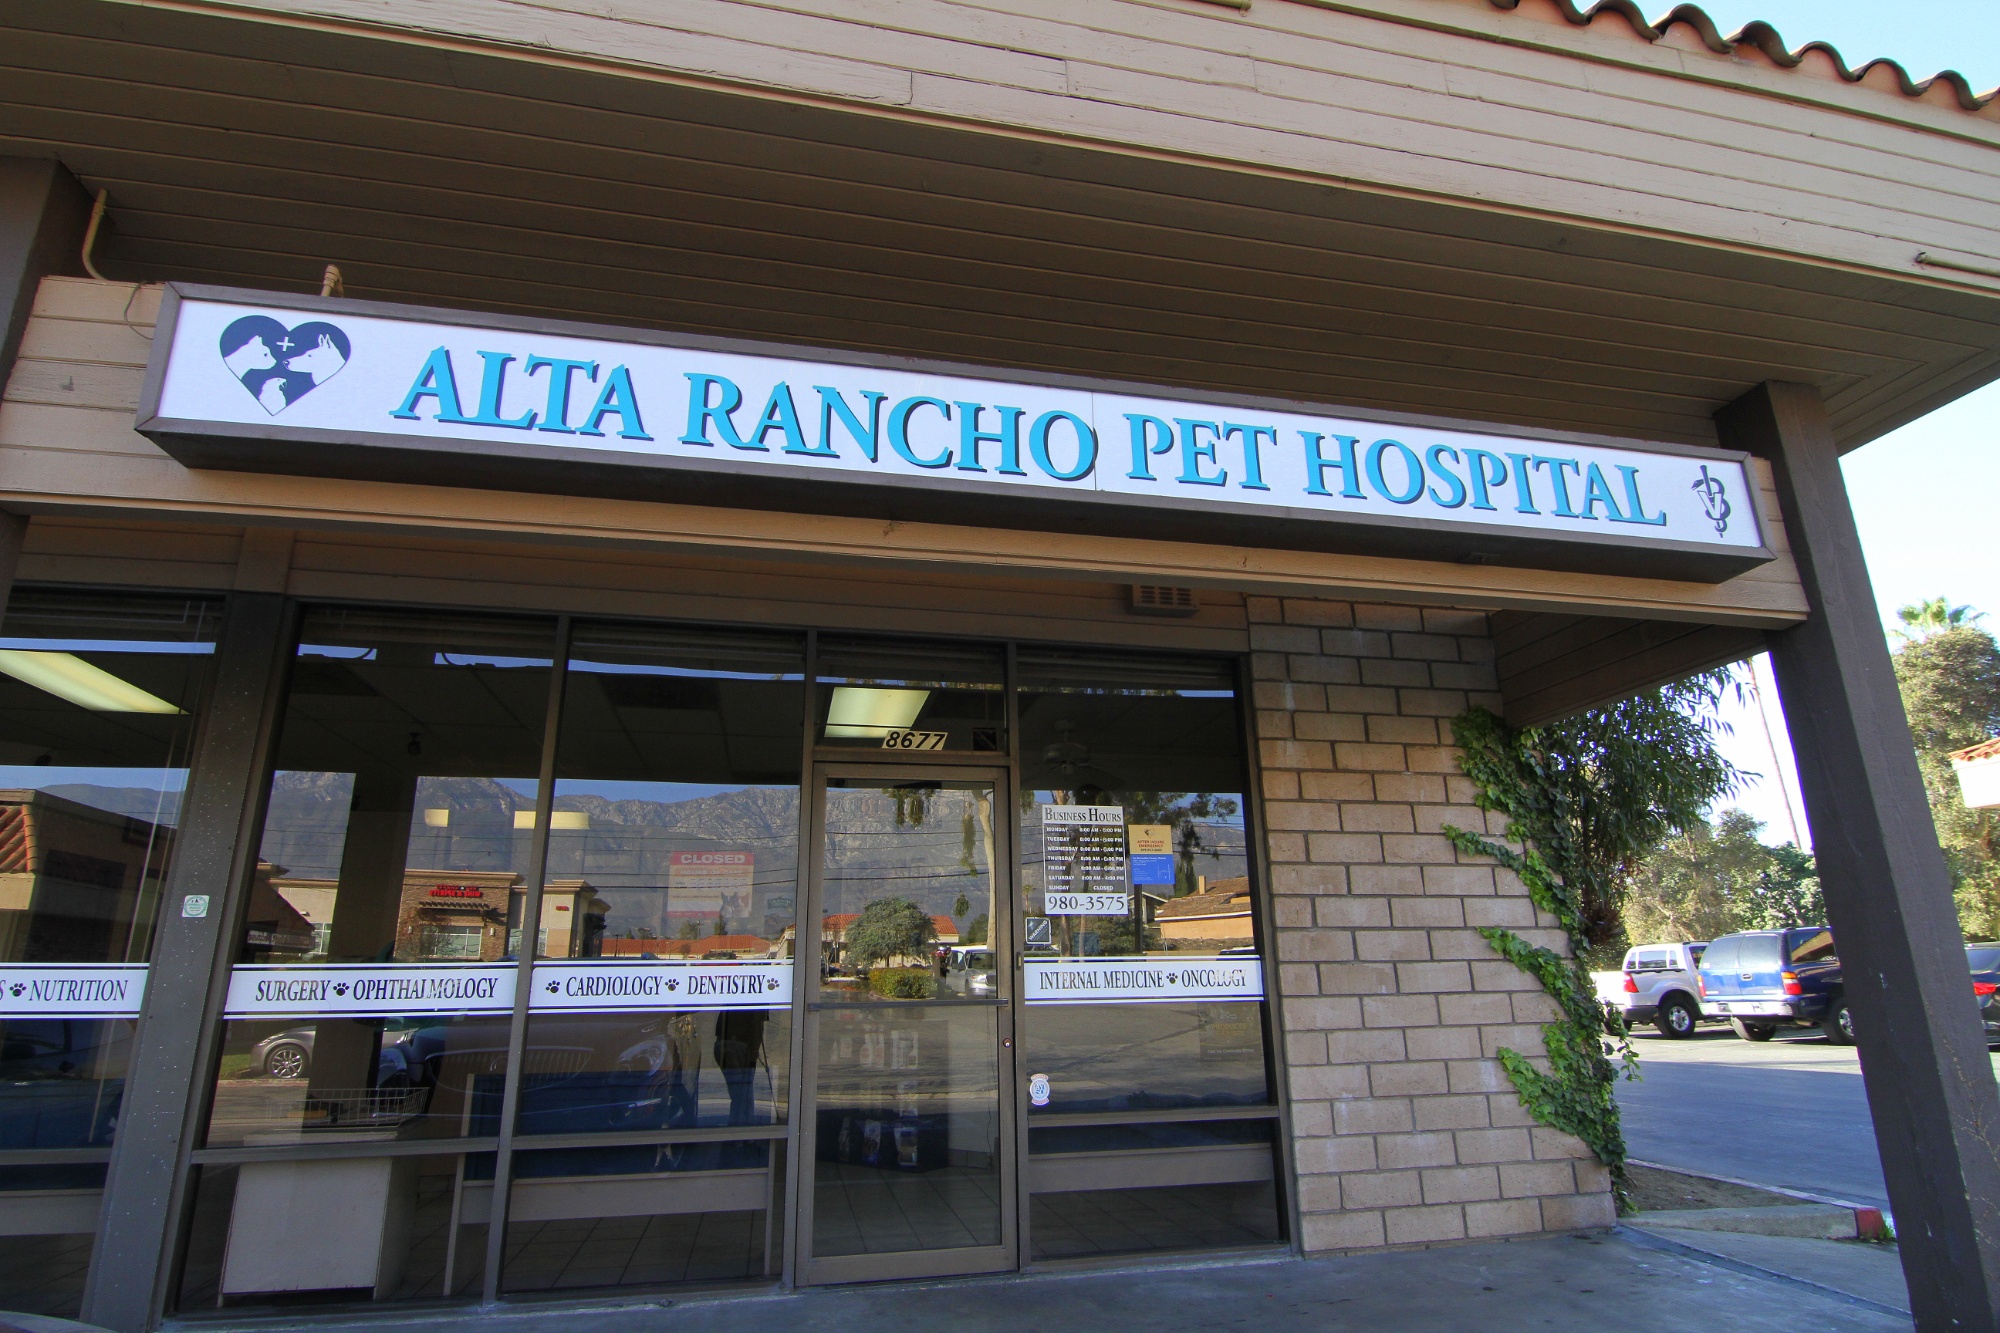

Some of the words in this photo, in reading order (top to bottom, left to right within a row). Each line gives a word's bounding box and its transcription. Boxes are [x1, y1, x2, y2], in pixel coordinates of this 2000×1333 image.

[388, 345, 654, 441] ALTA
[678, 372, 1099, 482] RANCHO
[1123, 413, 1277, 491] PET
[1297, 430, 1666, 527] HOSPITAL
[885, 731, 946, 750] 8677
[680, 854, 746, 864] CLOSED
[1048, 896, 1125, 911] 980-3575
[1028, 920, 1048, 940] WARNING
[28, 979, 129, 1001] NUTRITION
[565, 975, 664, 997] CARDIOLOGY
[687, 974, 766, 995] DENTISTRY
[1039, 971, 1101, 990] INTERNAL
[1103, 970, 1165, 989] MEDICINE
[255, 979, 331, 1002] SURGERY
